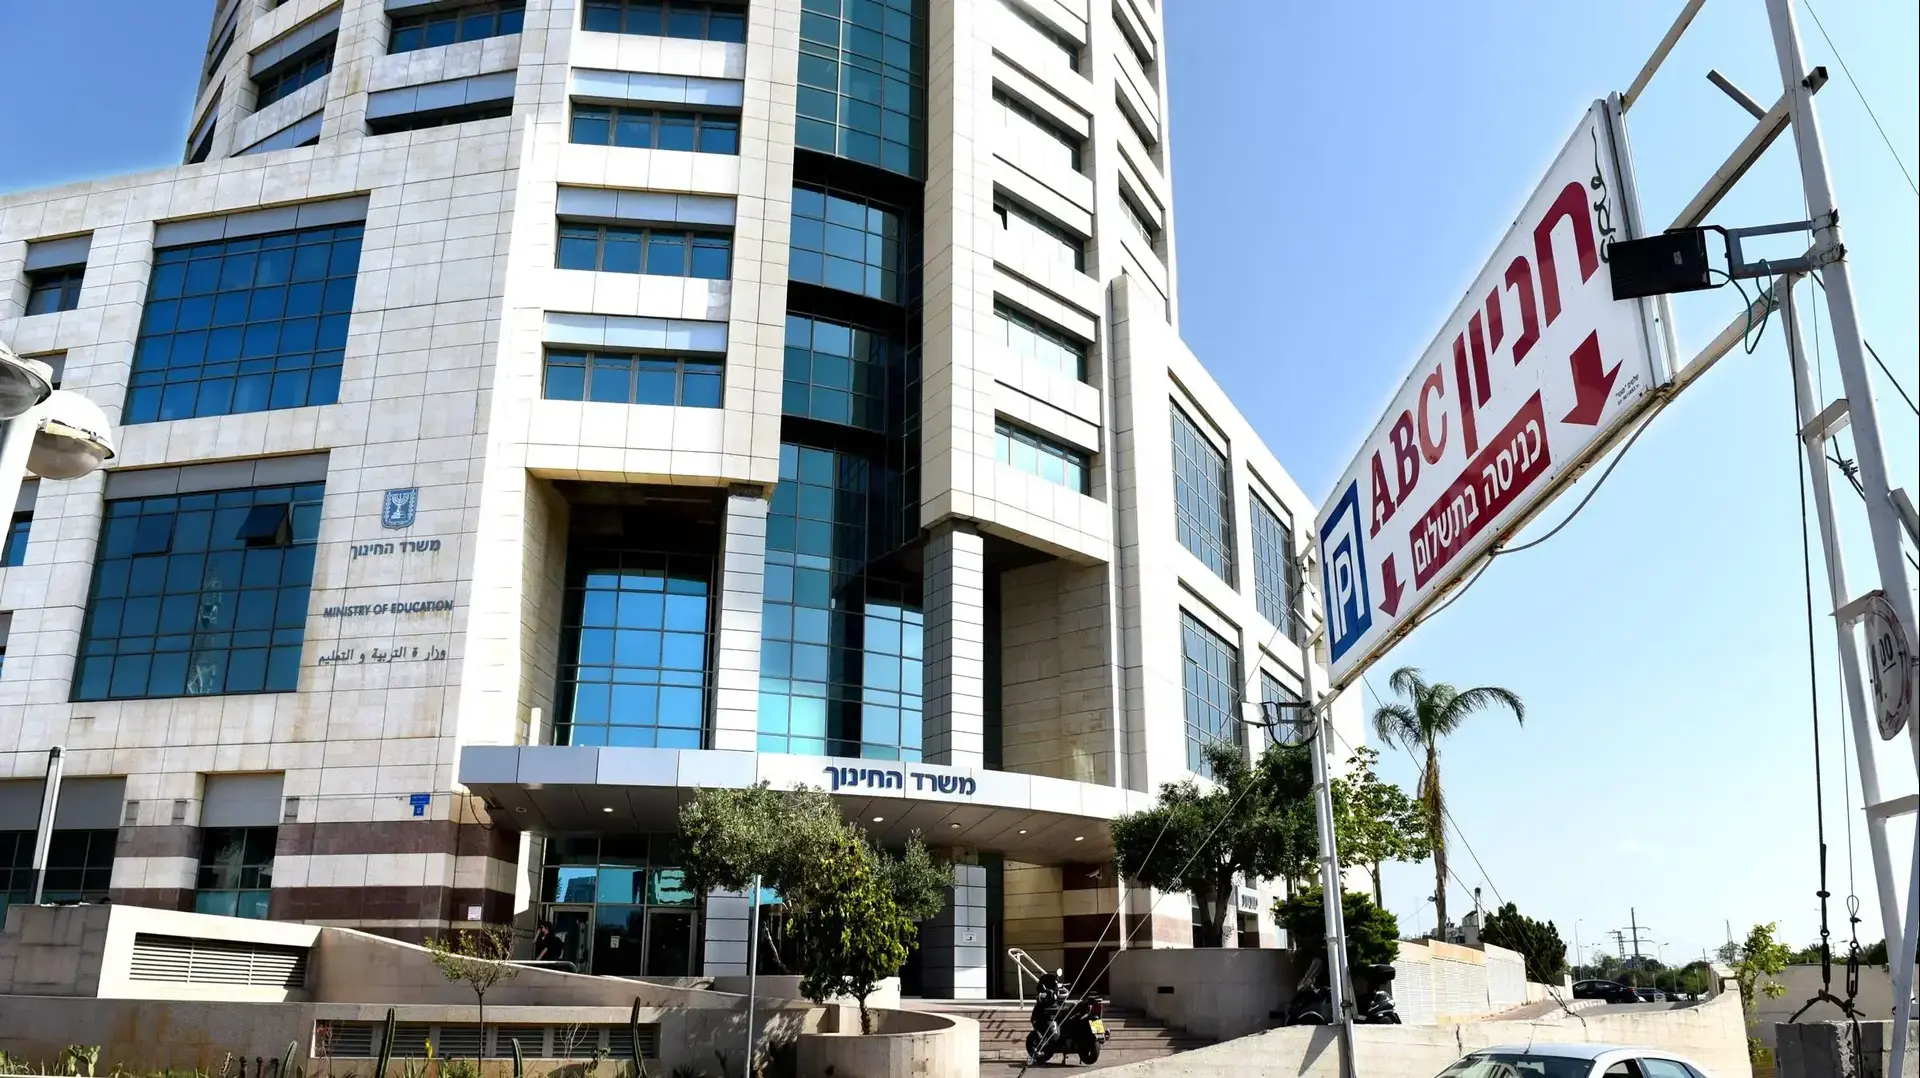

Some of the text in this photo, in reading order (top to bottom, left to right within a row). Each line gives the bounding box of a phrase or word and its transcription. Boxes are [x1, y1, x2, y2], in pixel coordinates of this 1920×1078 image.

[1370, 181, 1599, 540] חניון ABC
[1414, 419, 1542, 575] כניסה בתשלום
[350, 539, 441, 560] משרד החינוך
[323, 600, 454, 618] MINISTRY OF EDUCATION
[318, 649, 354, 666] التعليم
[372, 646, 407, 663] التربية
[823, 766, 977, 796] משרד החינוך
